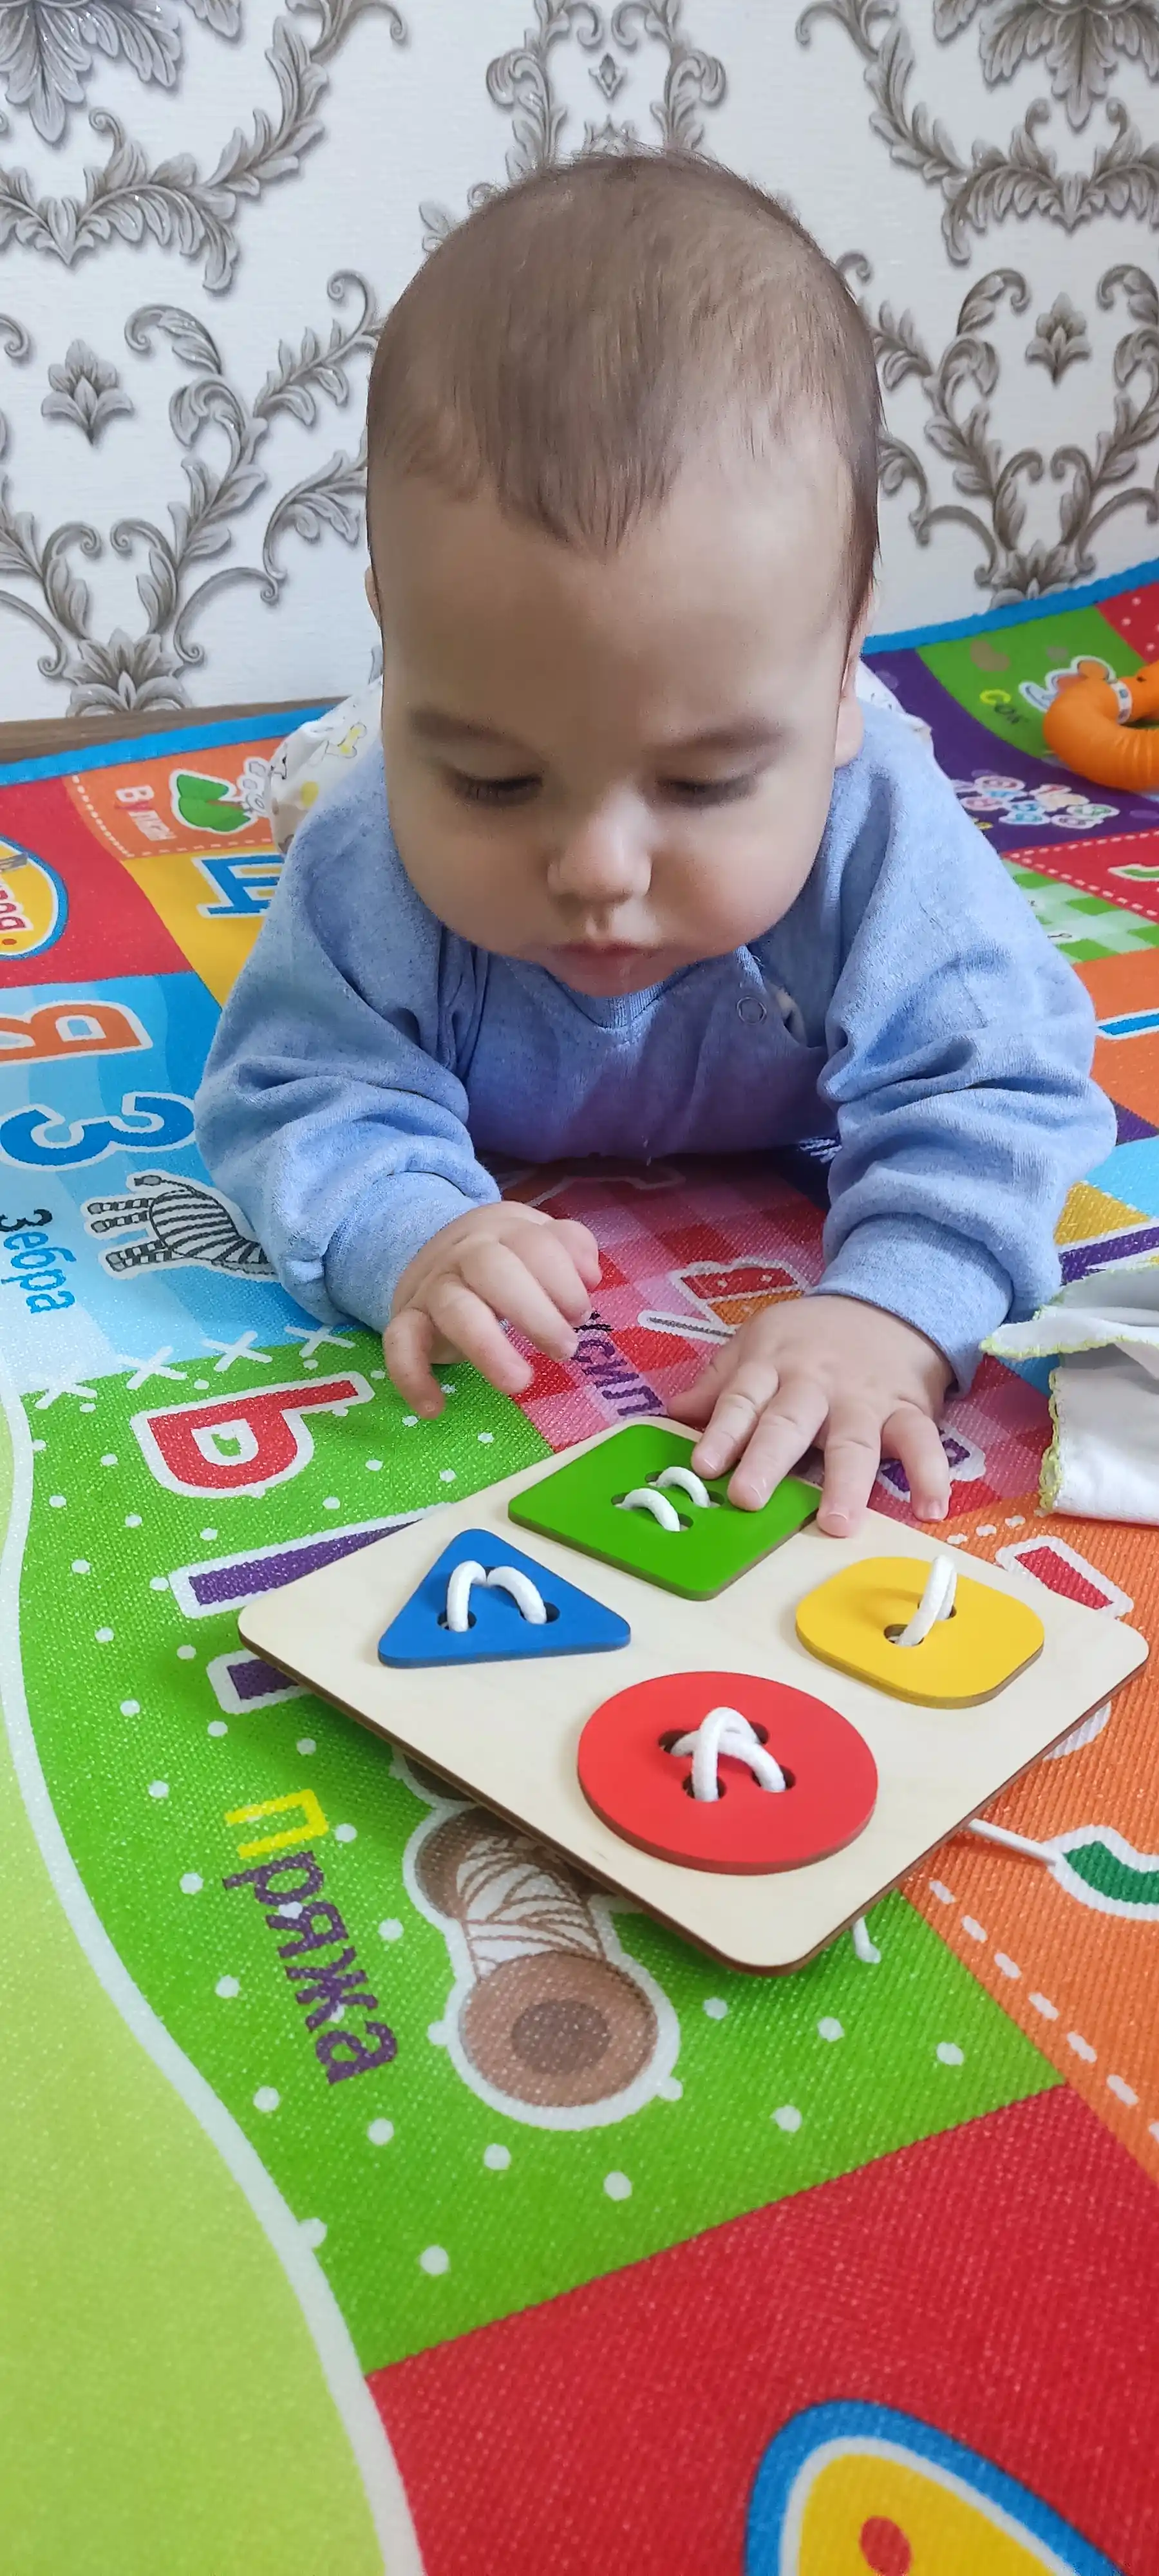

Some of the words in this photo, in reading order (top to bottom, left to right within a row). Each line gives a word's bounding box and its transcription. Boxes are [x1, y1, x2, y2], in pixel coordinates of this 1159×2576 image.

[0, 1093, 194, 1168] З
[0, 1209, 76, 1314] Зебра
[223, 1788, 398, 2085] Пряжа
